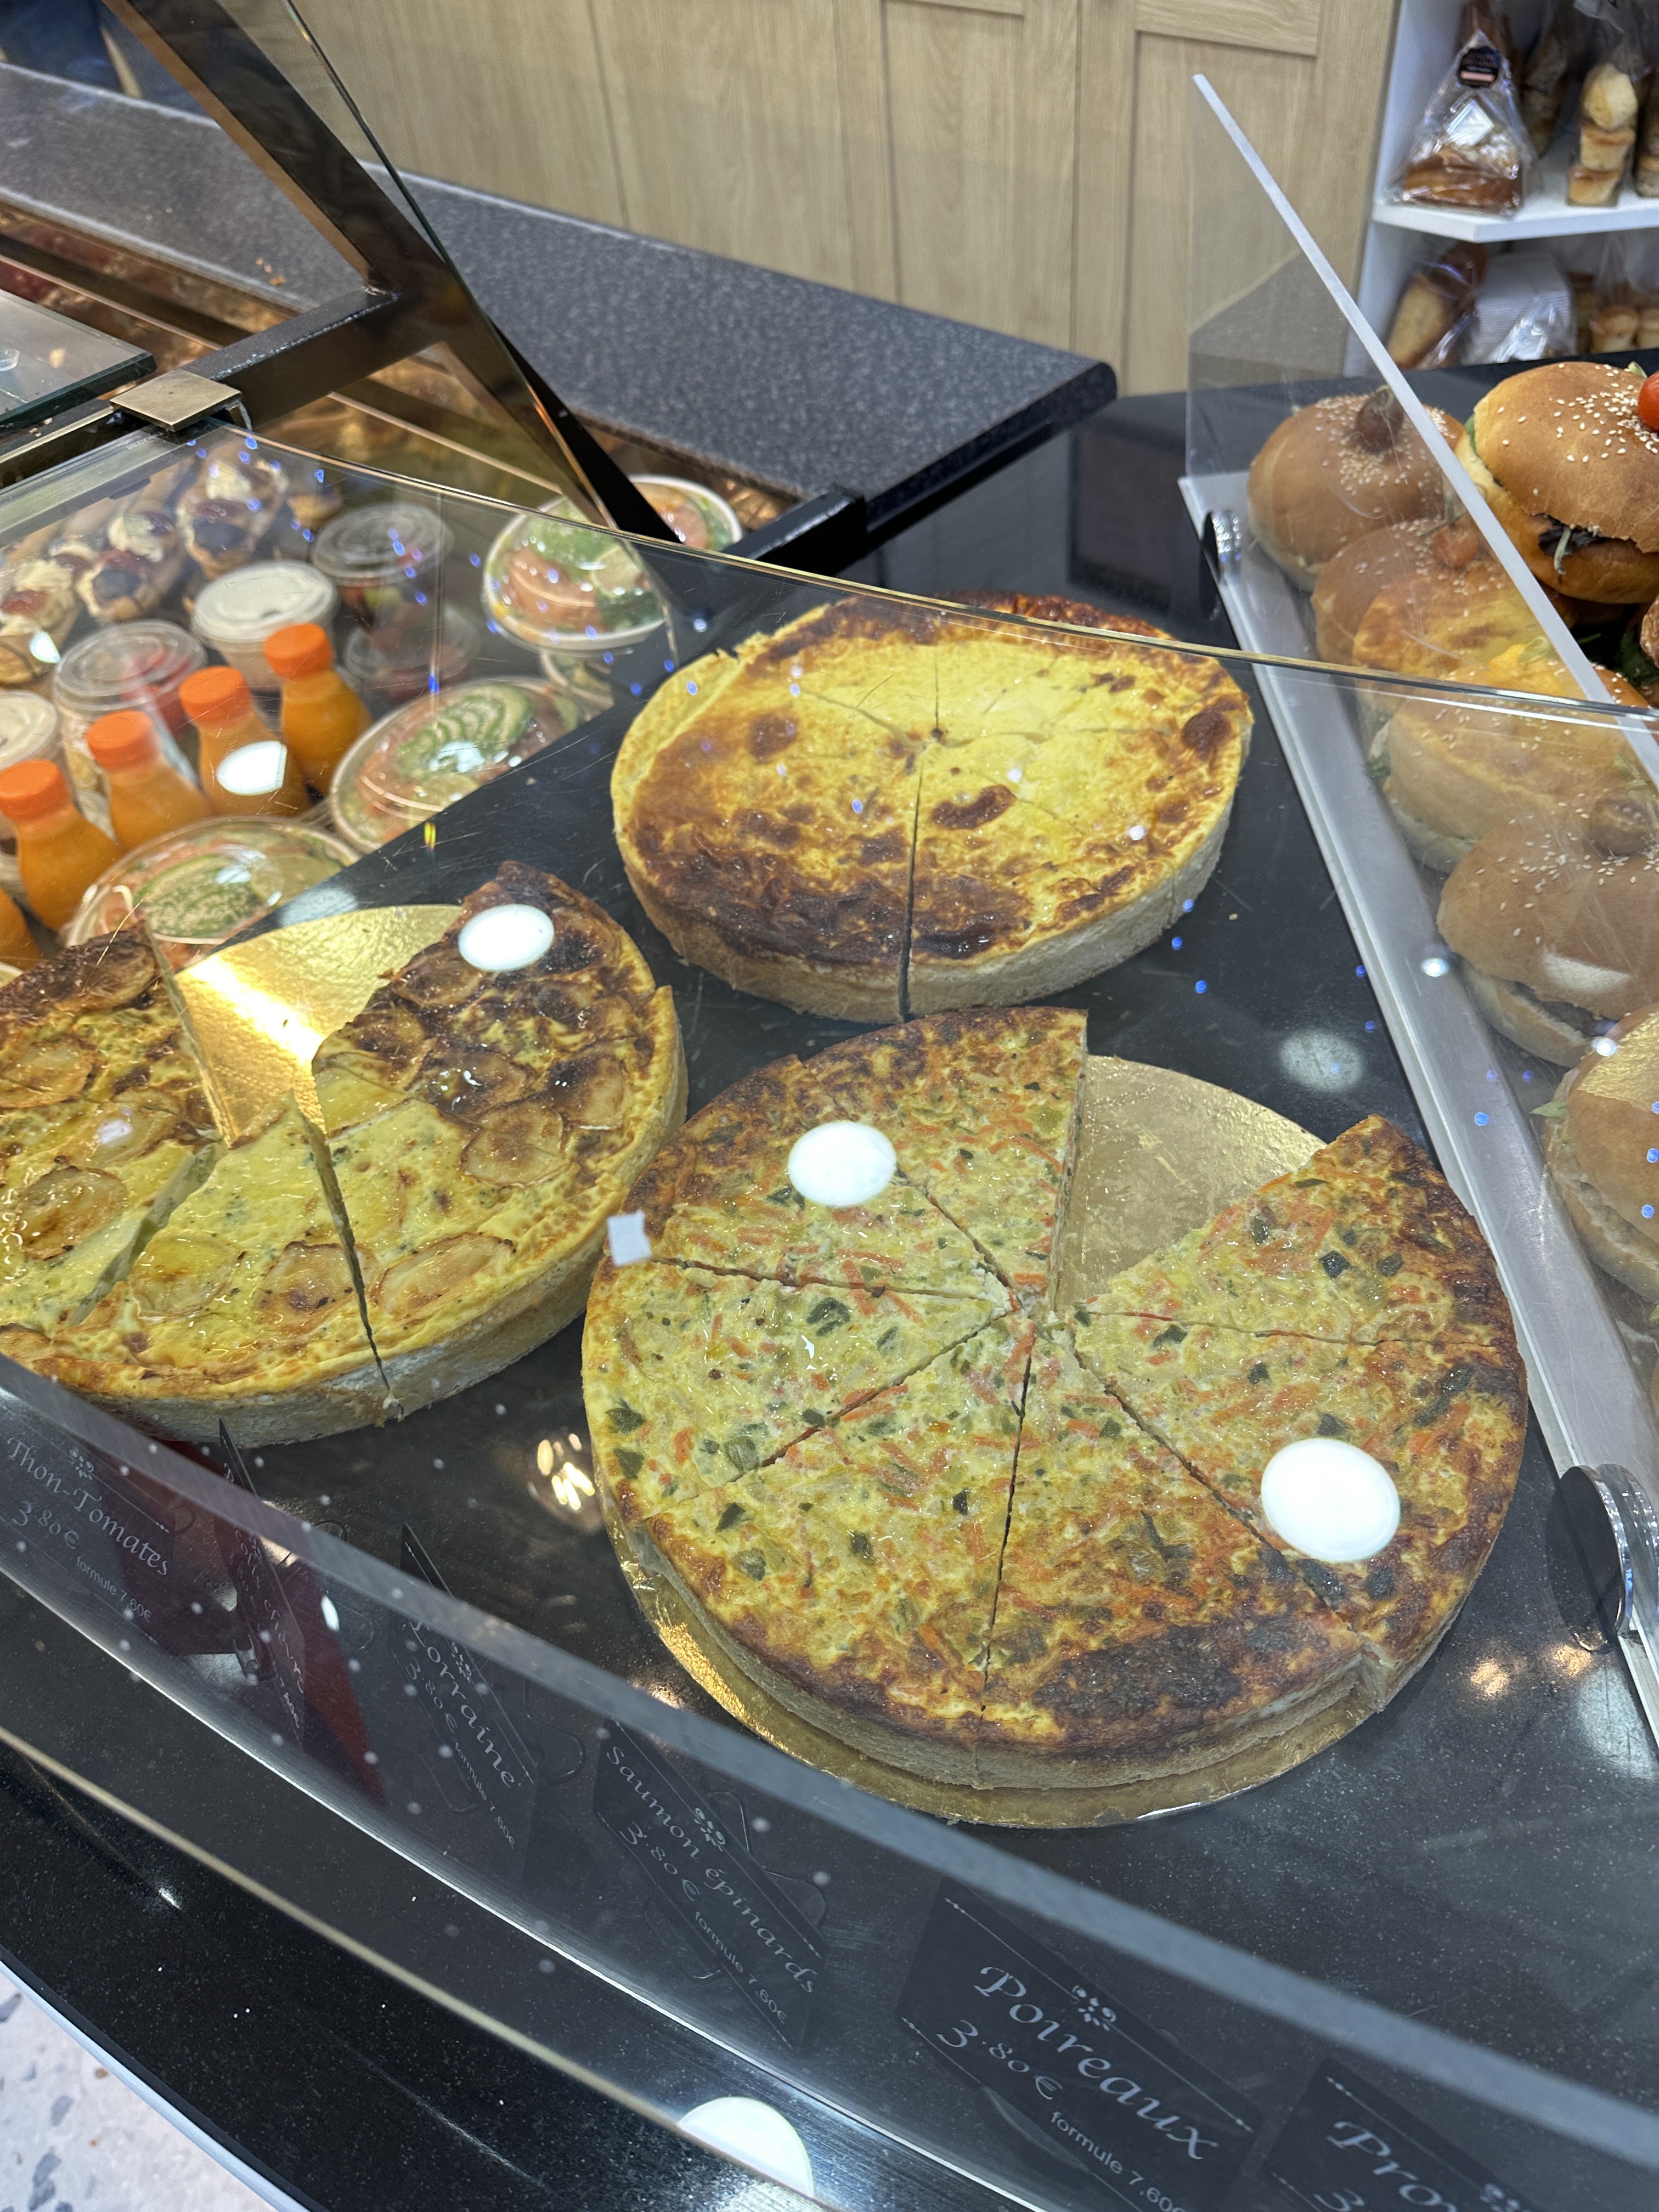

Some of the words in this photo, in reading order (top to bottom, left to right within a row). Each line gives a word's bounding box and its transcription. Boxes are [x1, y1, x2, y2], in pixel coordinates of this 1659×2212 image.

[7, 1437, 168, 1576] Thon-Tomates
[77, 1556, 117, 1595] formule
[409, 1620, 515, 1788] Lorraine
[455, 1742, 487, 1801] formule
[607, 1746, 701, 1860] Saumon
[703, 1868, 819, 1994] épinards
[695, 1911, 744, 1973] formule
[973, 1966, 1219, 2159] Poireaux
[1051, 2111, 1123, 2175] formule
[1326, 2120, 1459, 2212] Pro
